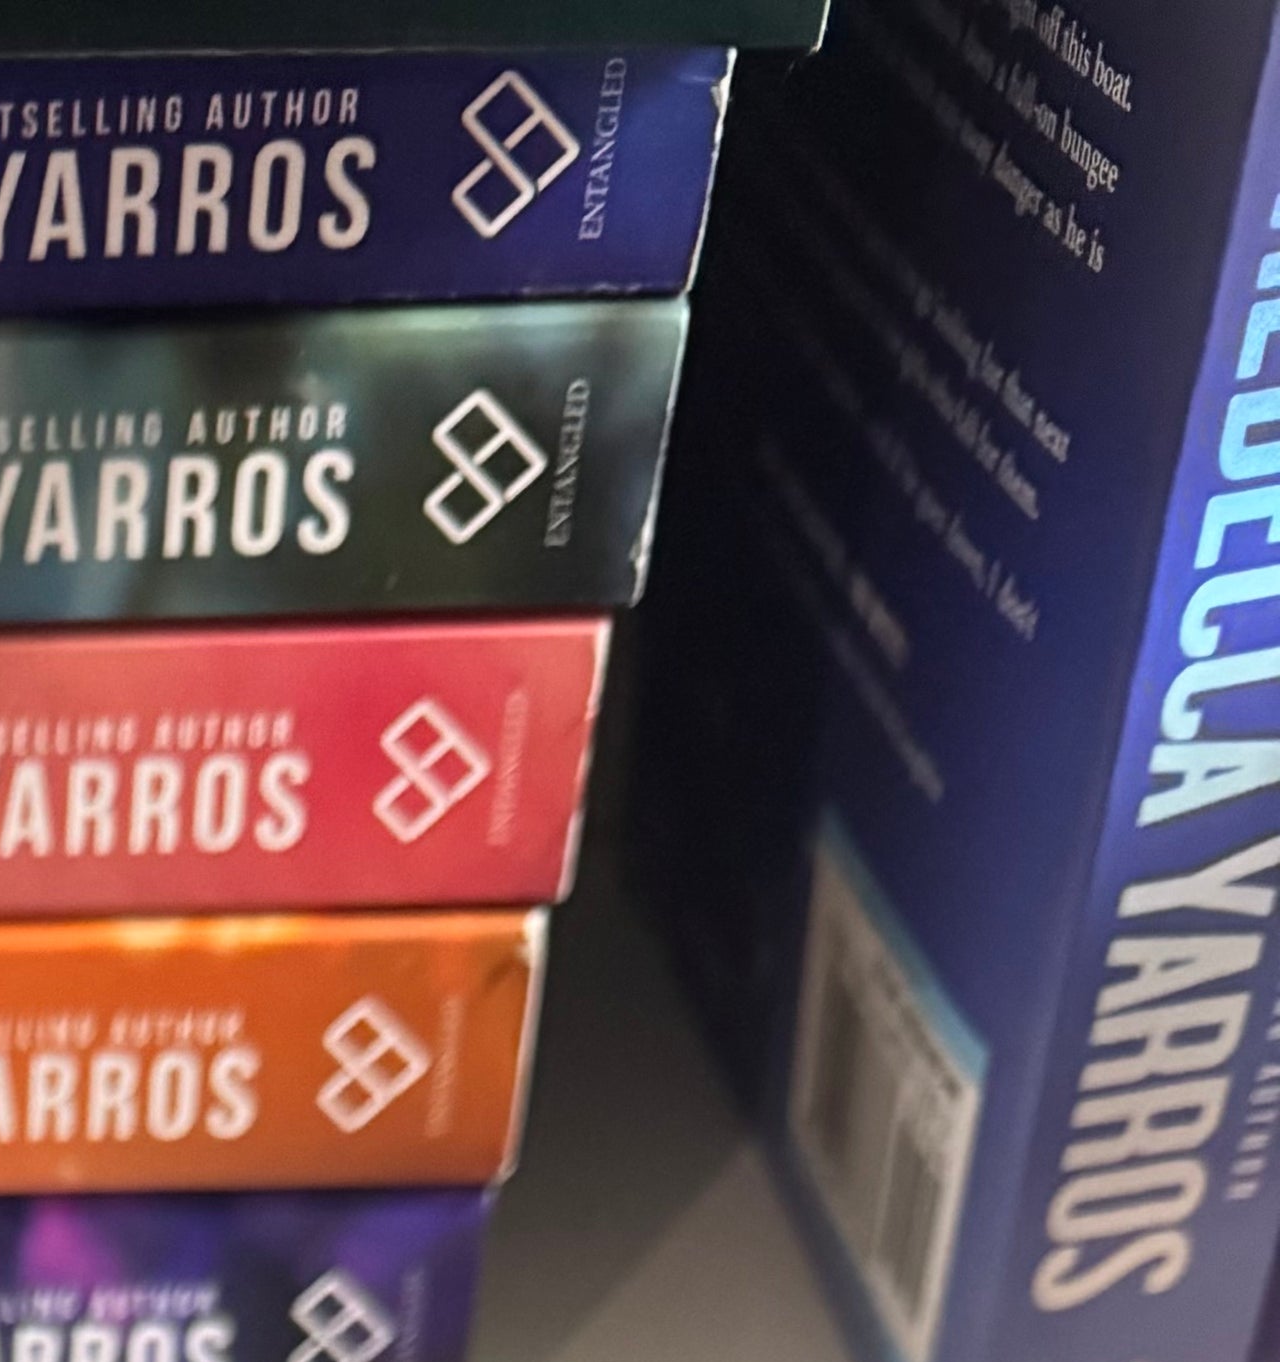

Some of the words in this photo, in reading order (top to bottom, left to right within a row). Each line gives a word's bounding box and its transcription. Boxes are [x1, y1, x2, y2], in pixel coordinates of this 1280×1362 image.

[1062, 20, 1090, 77] this
[1092, 41, 1131, 112] boat.
[205, 86, 360, 137] AUTHOR
[576, 56, 628, 242] ENTANGLED
[1061, 105, 1119, 193] bungee
[1043, 201, 1063, 236] as
[1064, 203, 1087, 257] he
[1088, 228, 1105, 273] is
[186, 401, 348, 447] AUTHOR
[1137, 190, 1280, 828] ECCA
[1031, 835, 1280, 1313] YARROS
